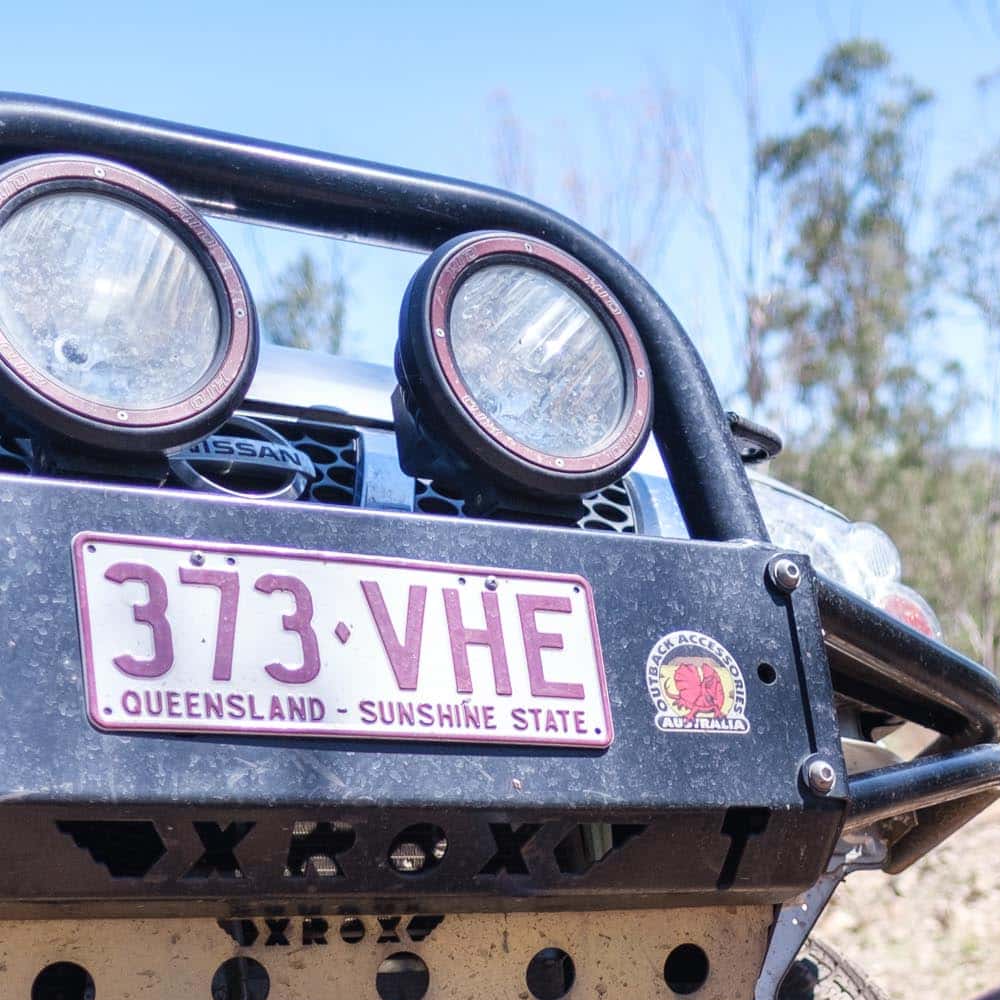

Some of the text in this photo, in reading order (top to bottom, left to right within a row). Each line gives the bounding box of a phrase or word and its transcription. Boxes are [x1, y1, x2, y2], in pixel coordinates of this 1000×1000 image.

[648, 634, 744, 714] OUTBACK ACCESSORIES
[121, 690, 325, 722] QUEENSLAND
[360, 700, 497, 730] SUNSHINE
[512, 708, 587, 734] STATE
[661, 717, 746, 730] AUSTRALIA
[182, 821, 546, 880] XROX
[264, 914, 402, 947] XROX
